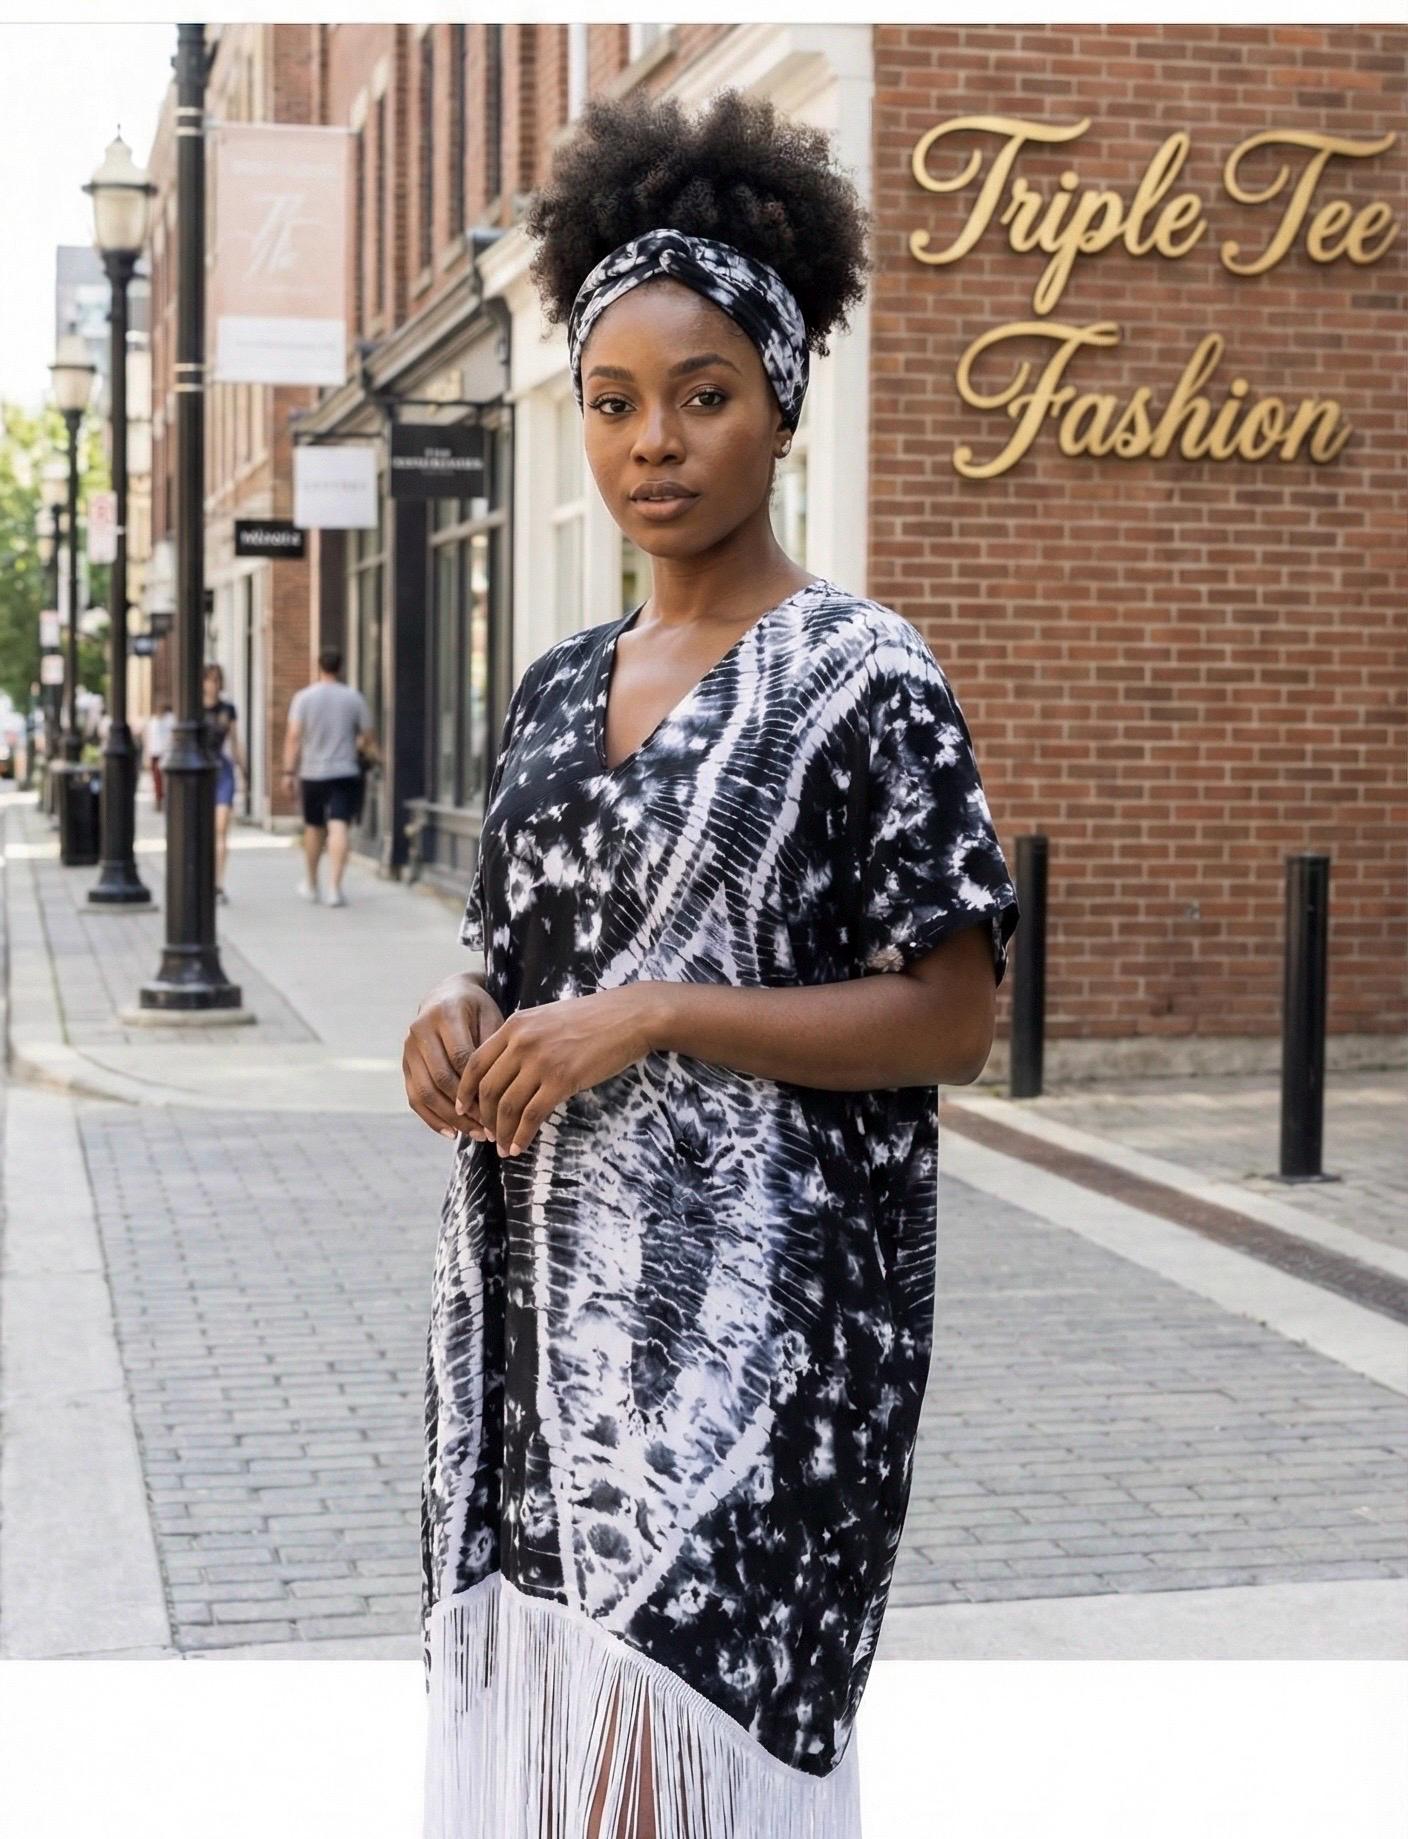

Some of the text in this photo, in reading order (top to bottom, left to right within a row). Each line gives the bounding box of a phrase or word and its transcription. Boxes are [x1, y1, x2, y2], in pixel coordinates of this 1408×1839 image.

[909, 115, 1397, 315] Triple Tee
[952, 320, 1350, 479] Fashion
